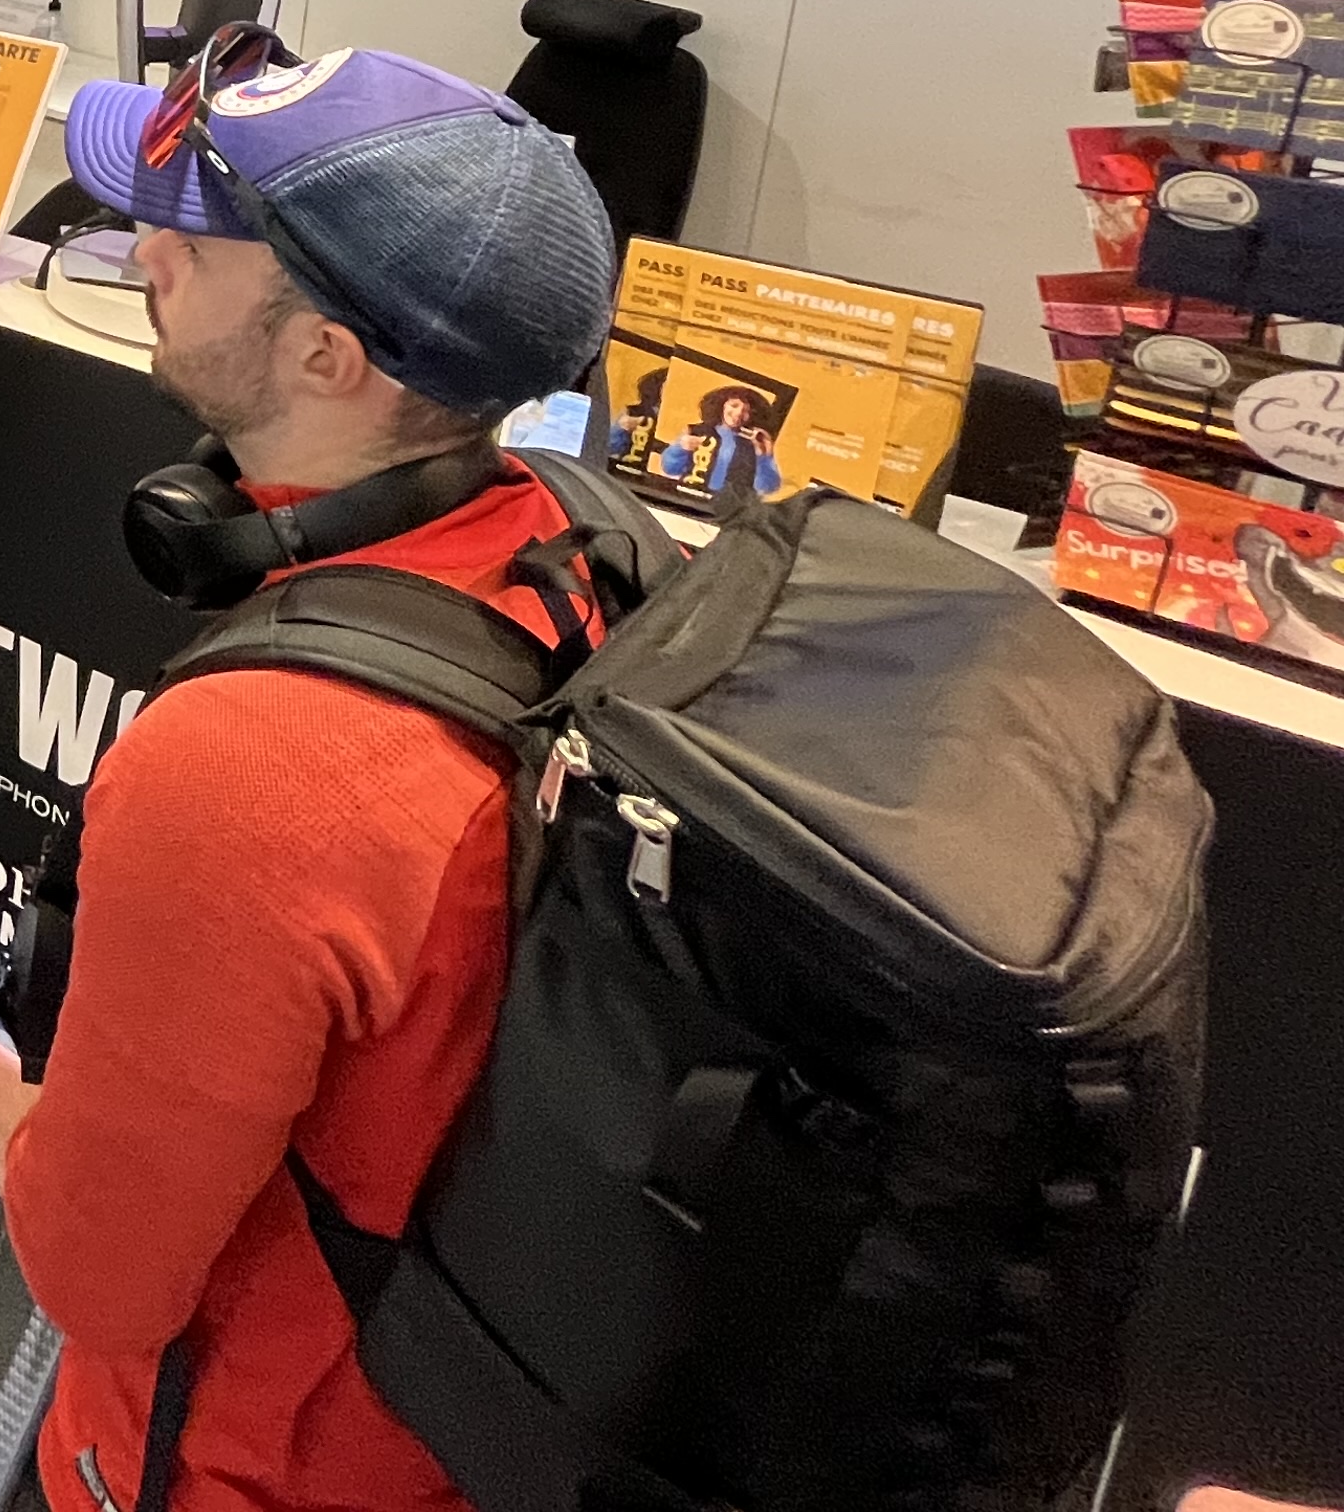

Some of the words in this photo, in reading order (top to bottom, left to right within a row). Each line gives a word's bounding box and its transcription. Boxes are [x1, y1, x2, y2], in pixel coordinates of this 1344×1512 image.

[638, 258, 684, 278] PASS
[700, 272, 749, 293] PASS
[755, 283, 896, 327] PARTENAIRES
